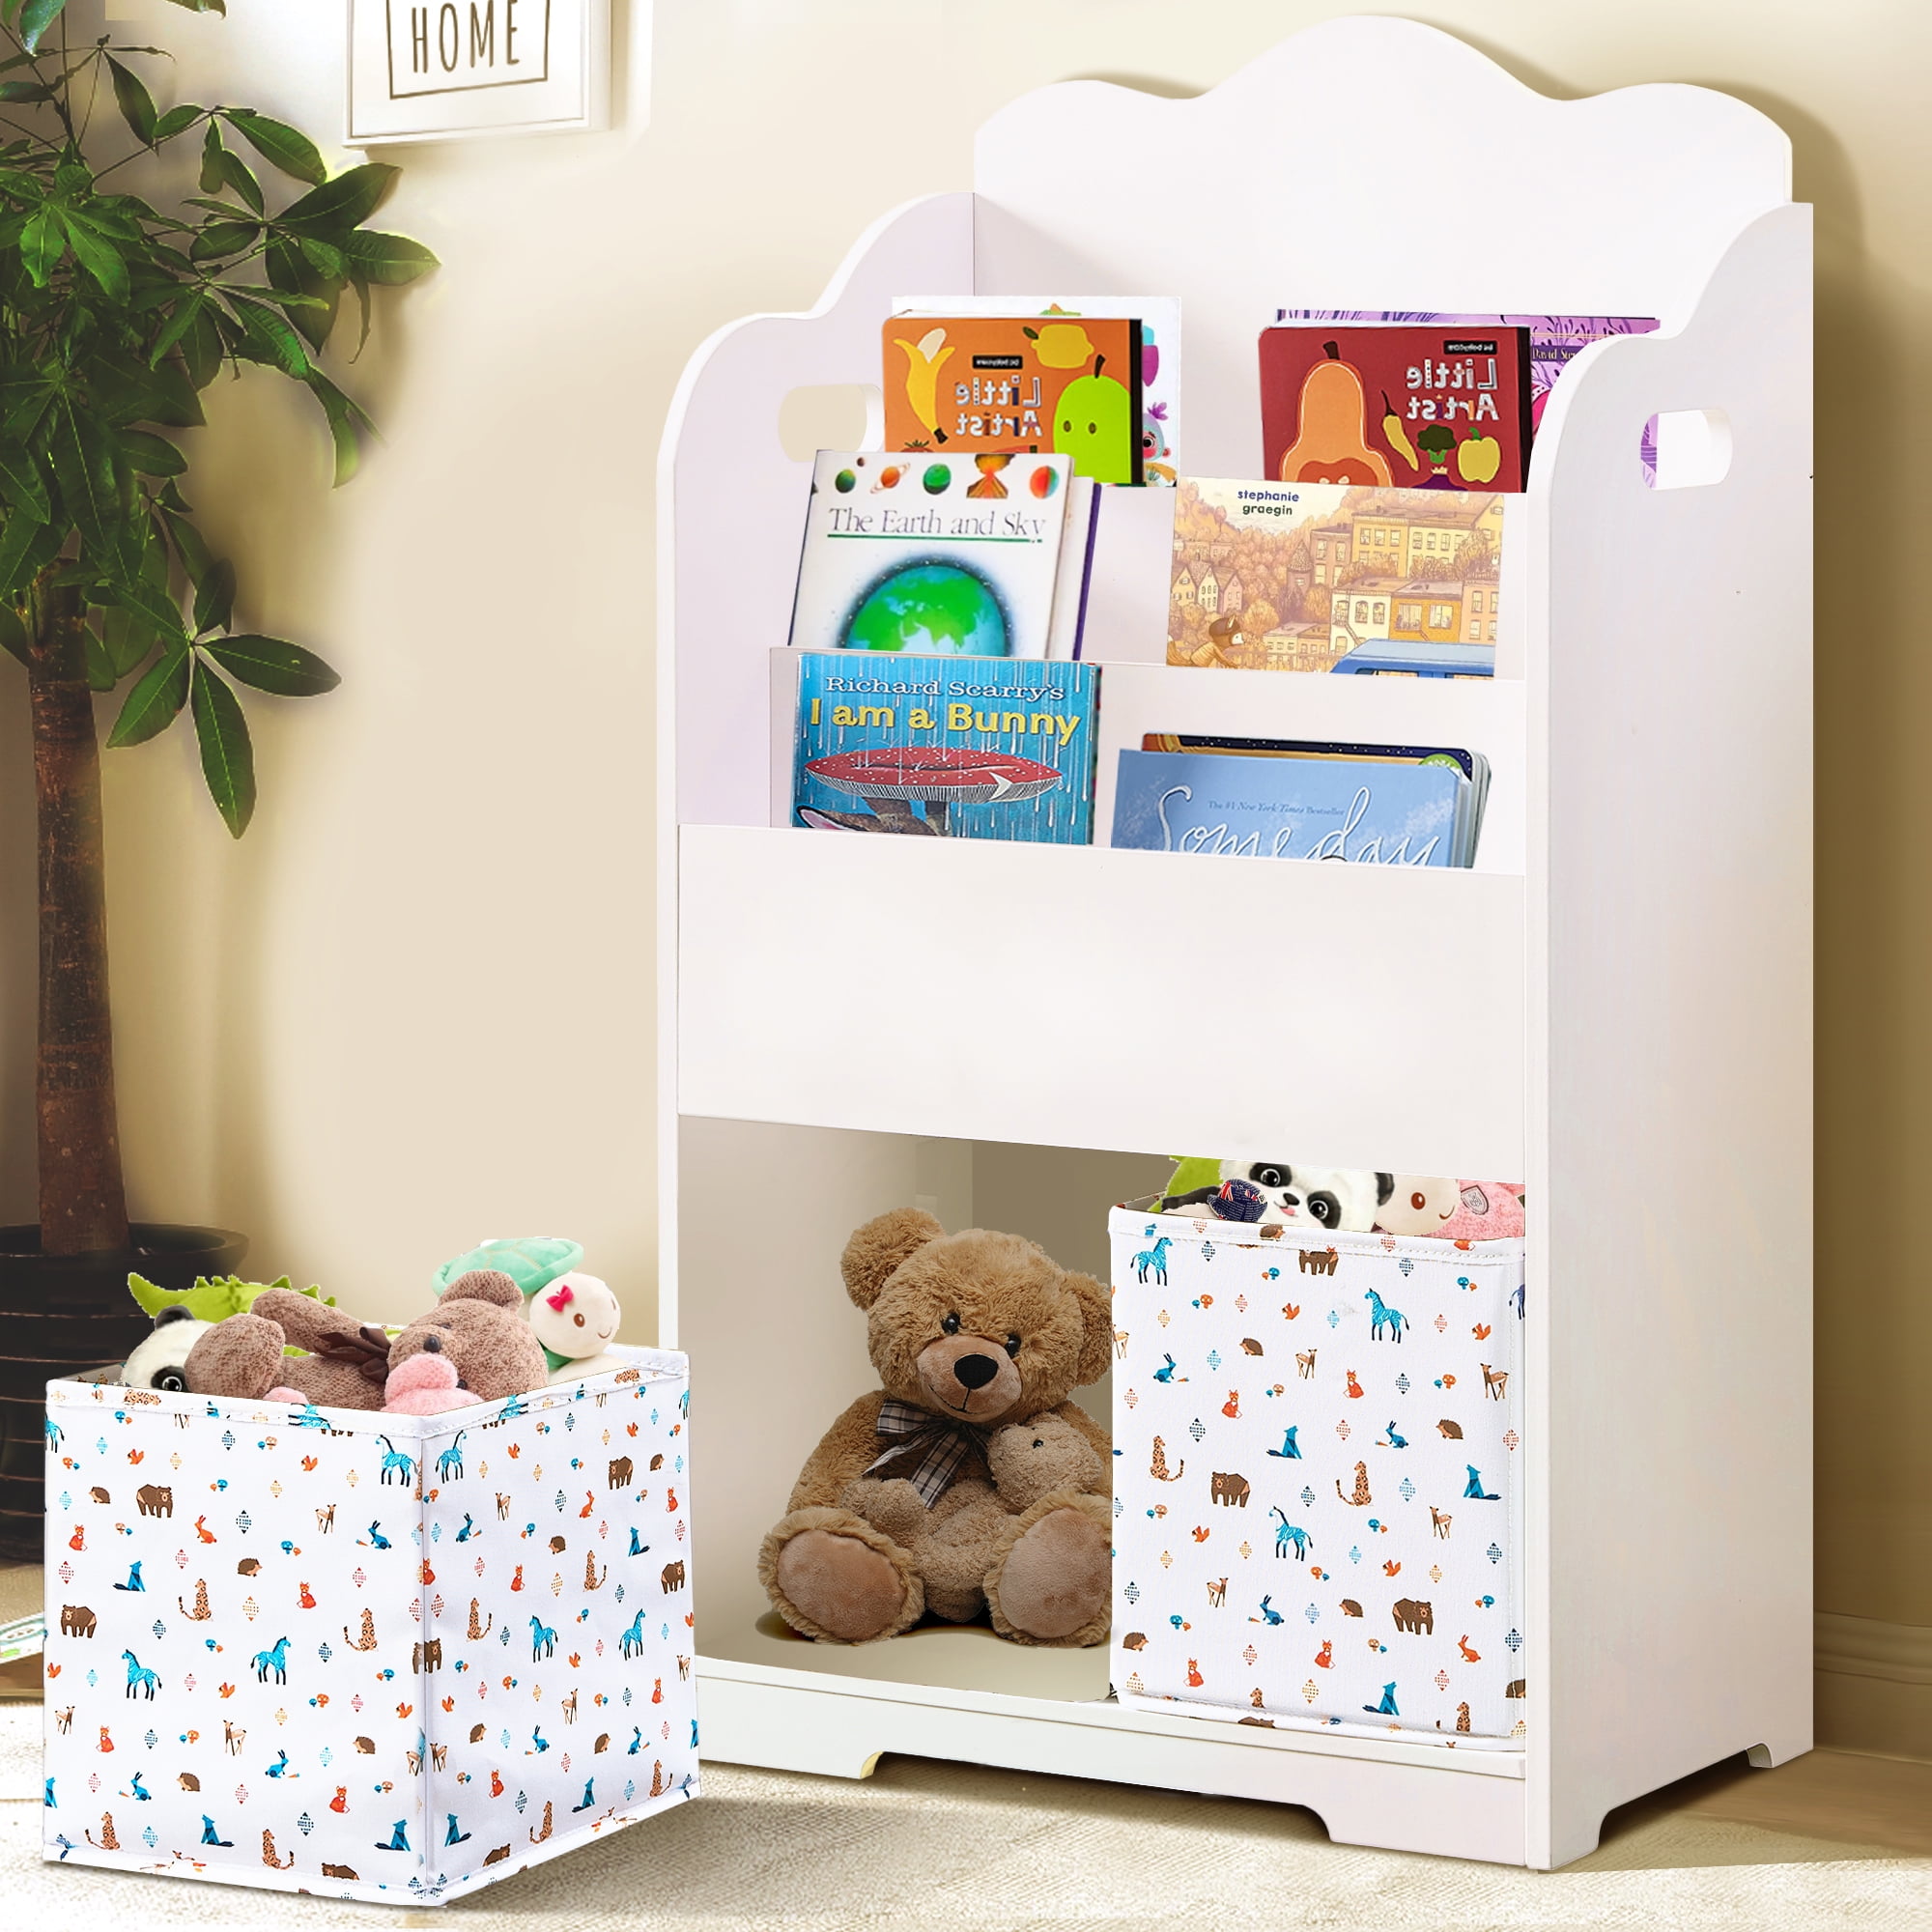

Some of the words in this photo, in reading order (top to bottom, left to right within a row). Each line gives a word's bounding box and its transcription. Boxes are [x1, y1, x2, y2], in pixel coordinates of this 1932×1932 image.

[412, 0, 520, 73] HOME
[1532, 347, 1557, 359] David
[1237, 489, 1299, 502] stephanie
[1242, 504, 1293, 517] graegin
[829, 507, 873, 532] The
[881, 509, 942, 534] Earth
[951, 511, 995, 536] and
[1002, 512, 1046, 539] Sky
[826, 676, 942, 696] Richard
[948, 680, 1065, 702] Scarry's
[810, 697, 821, 725] I
[831, 704, 895, 727] am
[909, 707, 935, 730] a
[947, 702, 1081, 746] Bunny
[1208, 801, 1222, 810] The
[1237, 802, 1255, 810] New
[1258, 802, 1276, 812] York
[1280, 804, 1304, 813] Times
[1306, 806, 1345, 815] Bestseller
